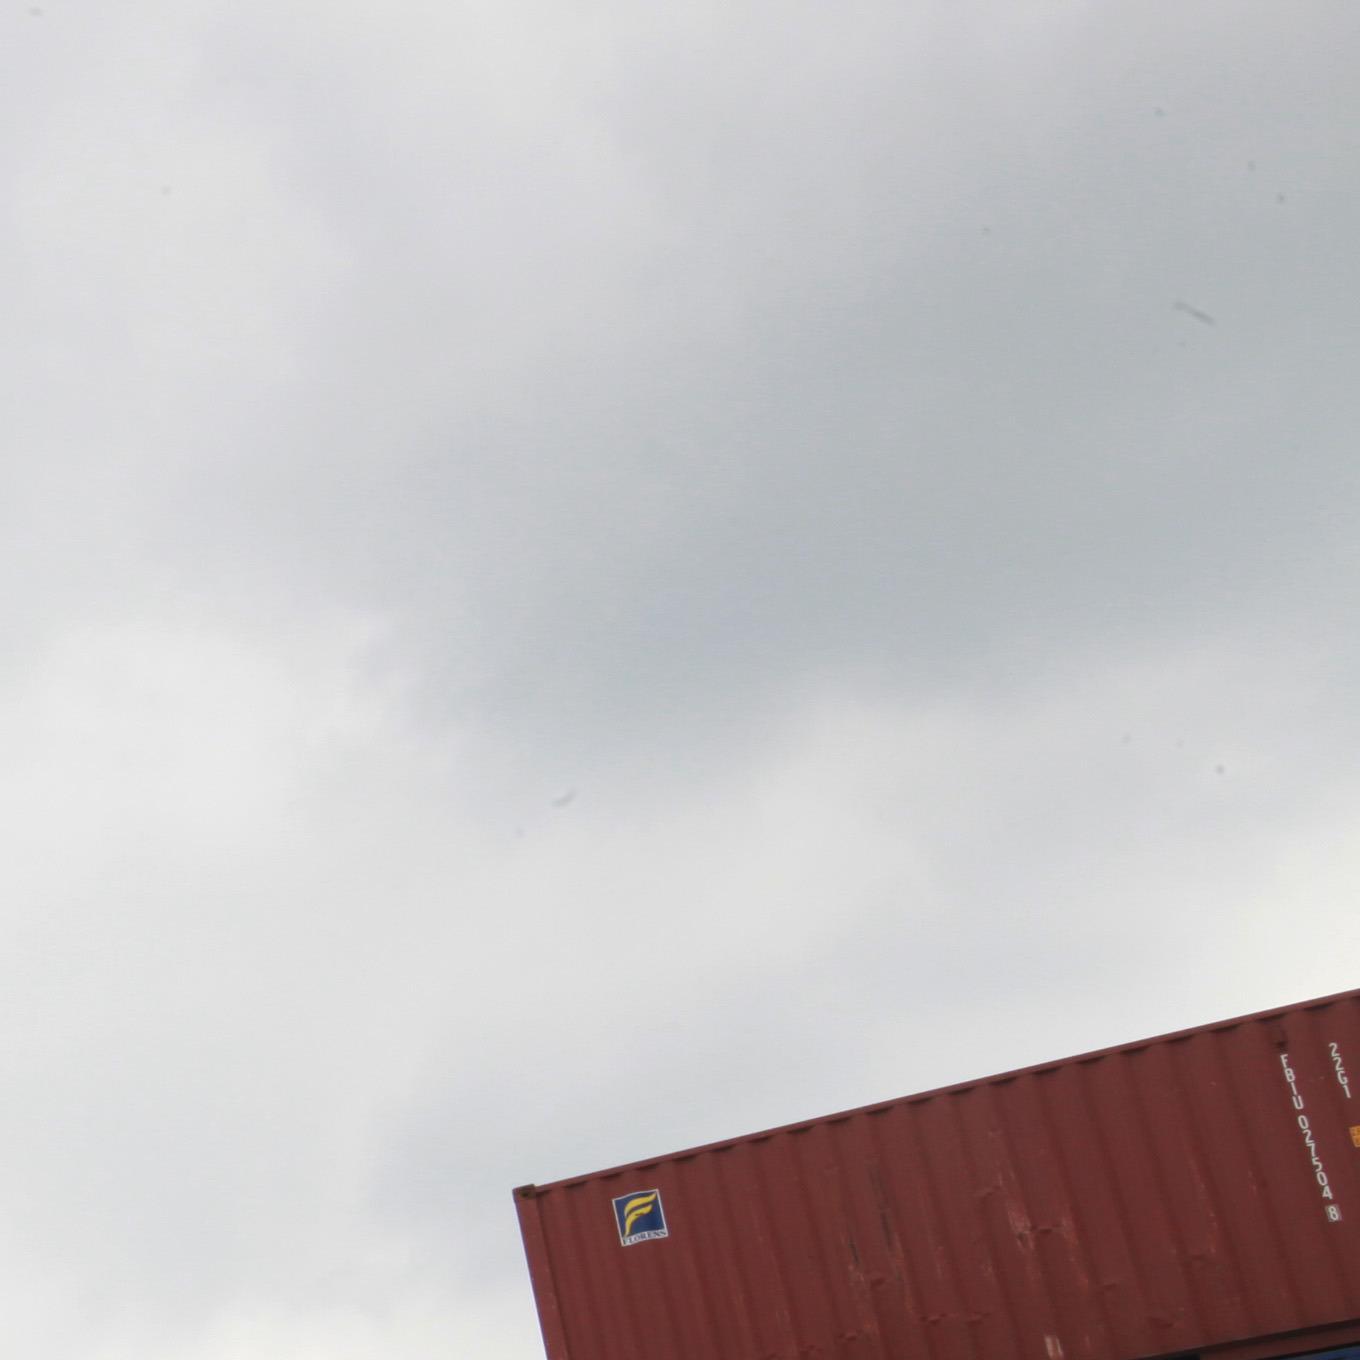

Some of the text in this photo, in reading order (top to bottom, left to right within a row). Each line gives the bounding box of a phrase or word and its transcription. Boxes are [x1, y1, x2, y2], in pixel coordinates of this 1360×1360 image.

[1328, 1042, 1352, 1099] 22G1
[1279, 1053, 1341, 1222] FBIU 027504 8
